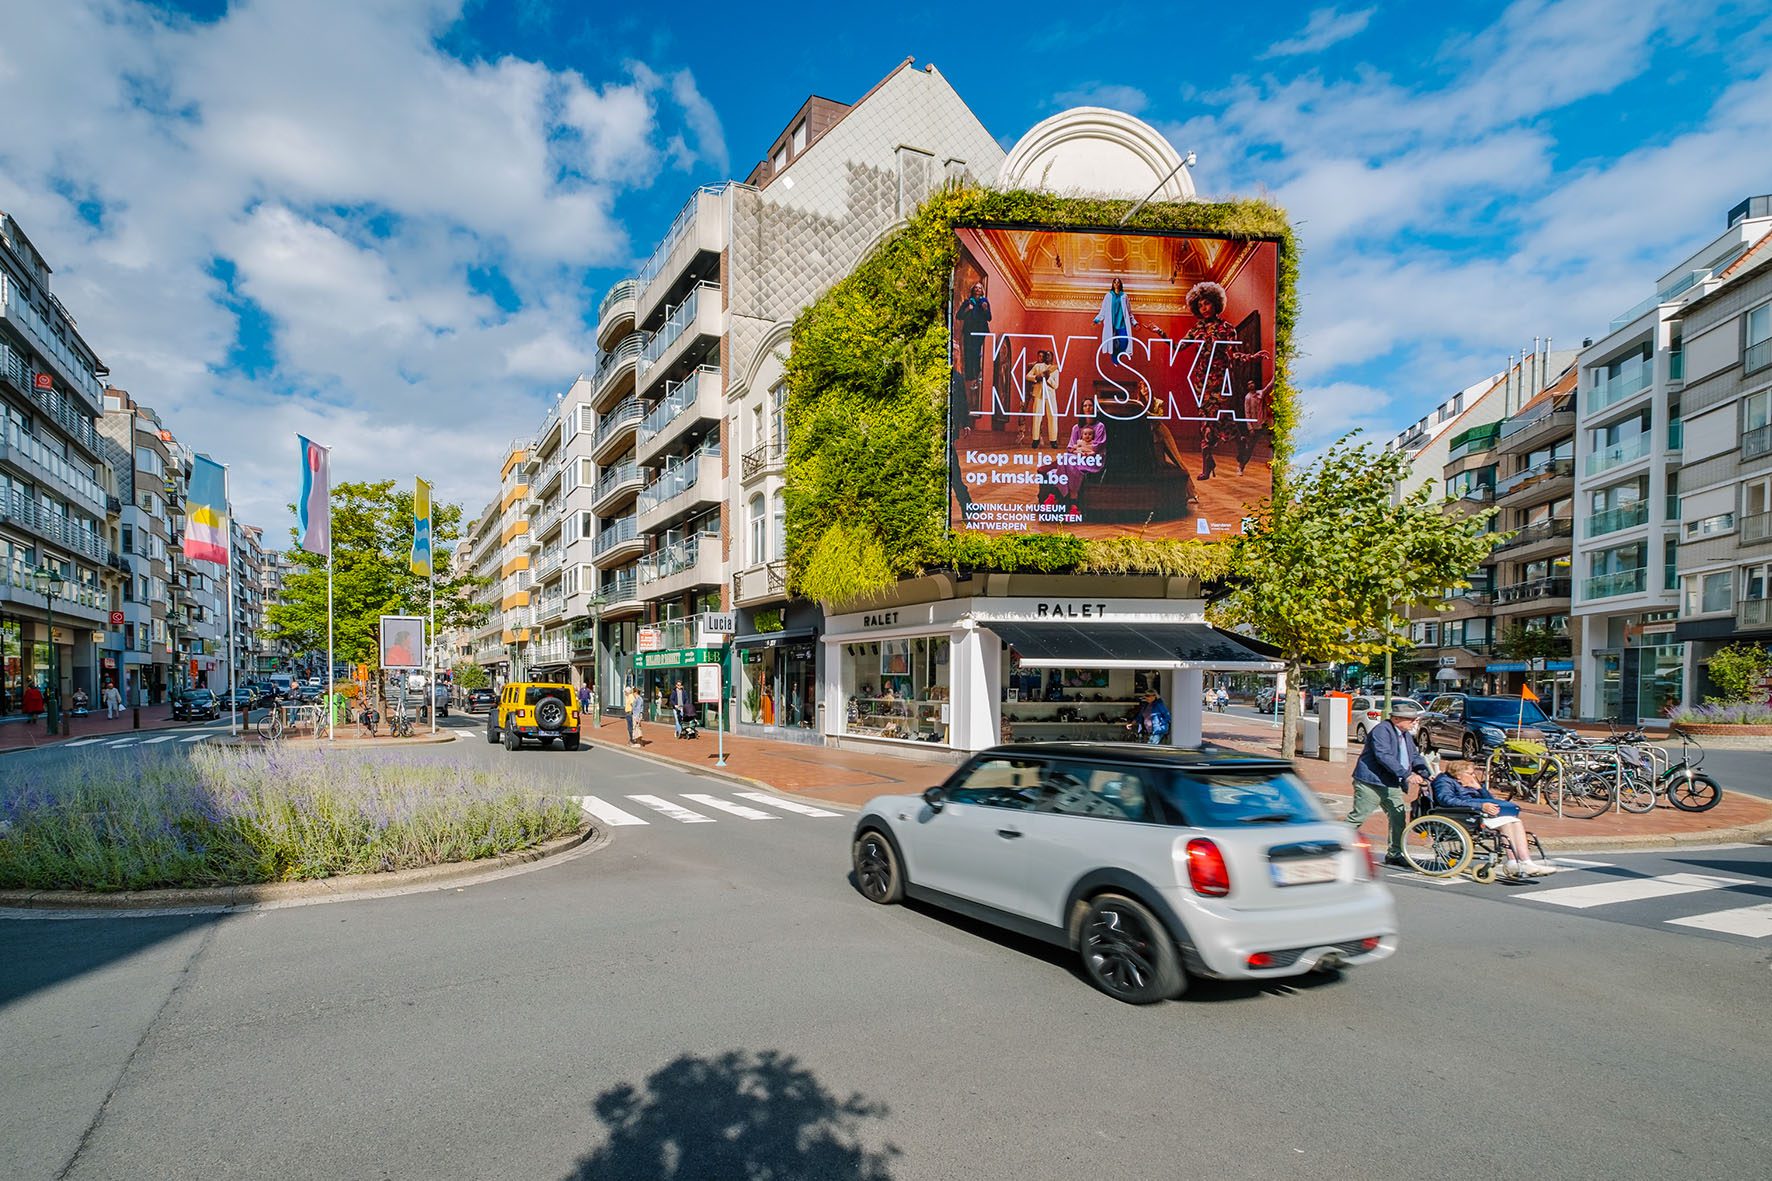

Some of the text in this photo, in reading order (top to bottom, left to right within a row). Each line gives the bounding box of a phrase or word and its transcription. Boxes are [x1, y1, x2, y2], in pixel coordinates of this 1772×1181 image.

[969, 332, 1258, 421] KMSKA
[966, 451, 1103, 468] Koop nu je ticket
[965, 469, 1069, 486] op kmska.be
[966, 502, 1067, 513] KONINKLIJK MUSEUM
[965, 512, 1083, 523] VOOR SCHONE KUNSTEN
[965, 521, 1027, 531] ANTWERPEN
[1037, 603, 1107, 618] RALET
[708, 615, 732, 631] Lucia
[863, 611, 899, 627] RALET
